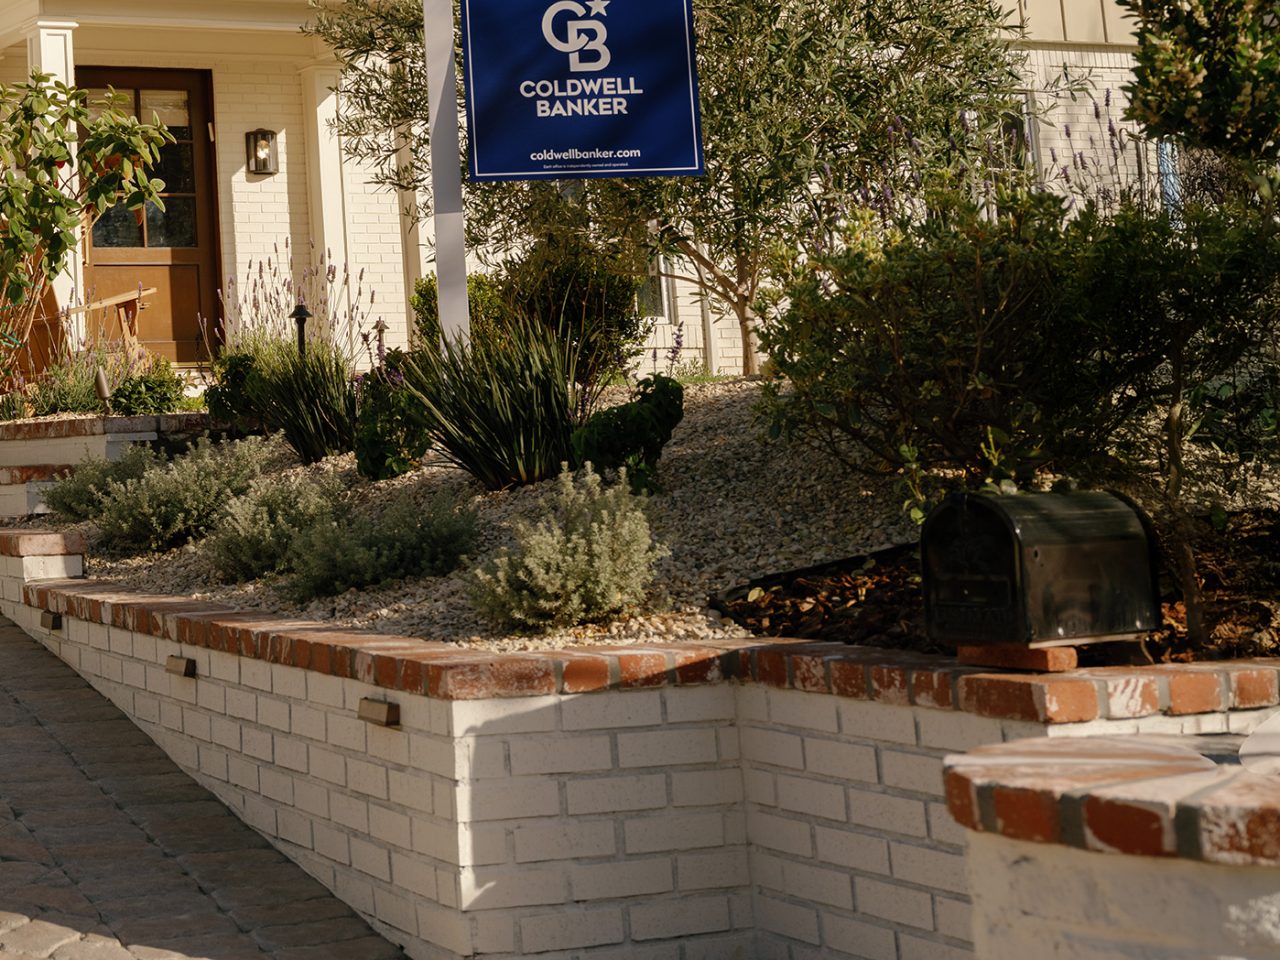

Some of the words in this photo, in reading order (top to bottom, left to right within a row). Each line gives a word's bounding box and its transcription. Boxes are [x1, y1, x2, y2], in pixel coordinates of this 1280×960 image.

[541, 0, 611, 73] CB
[519, 77, 643, 98] COLDWELL
[536, 97, 628, 117] BANKER
[529, 147, 641, 162] coldwellbanker.com
